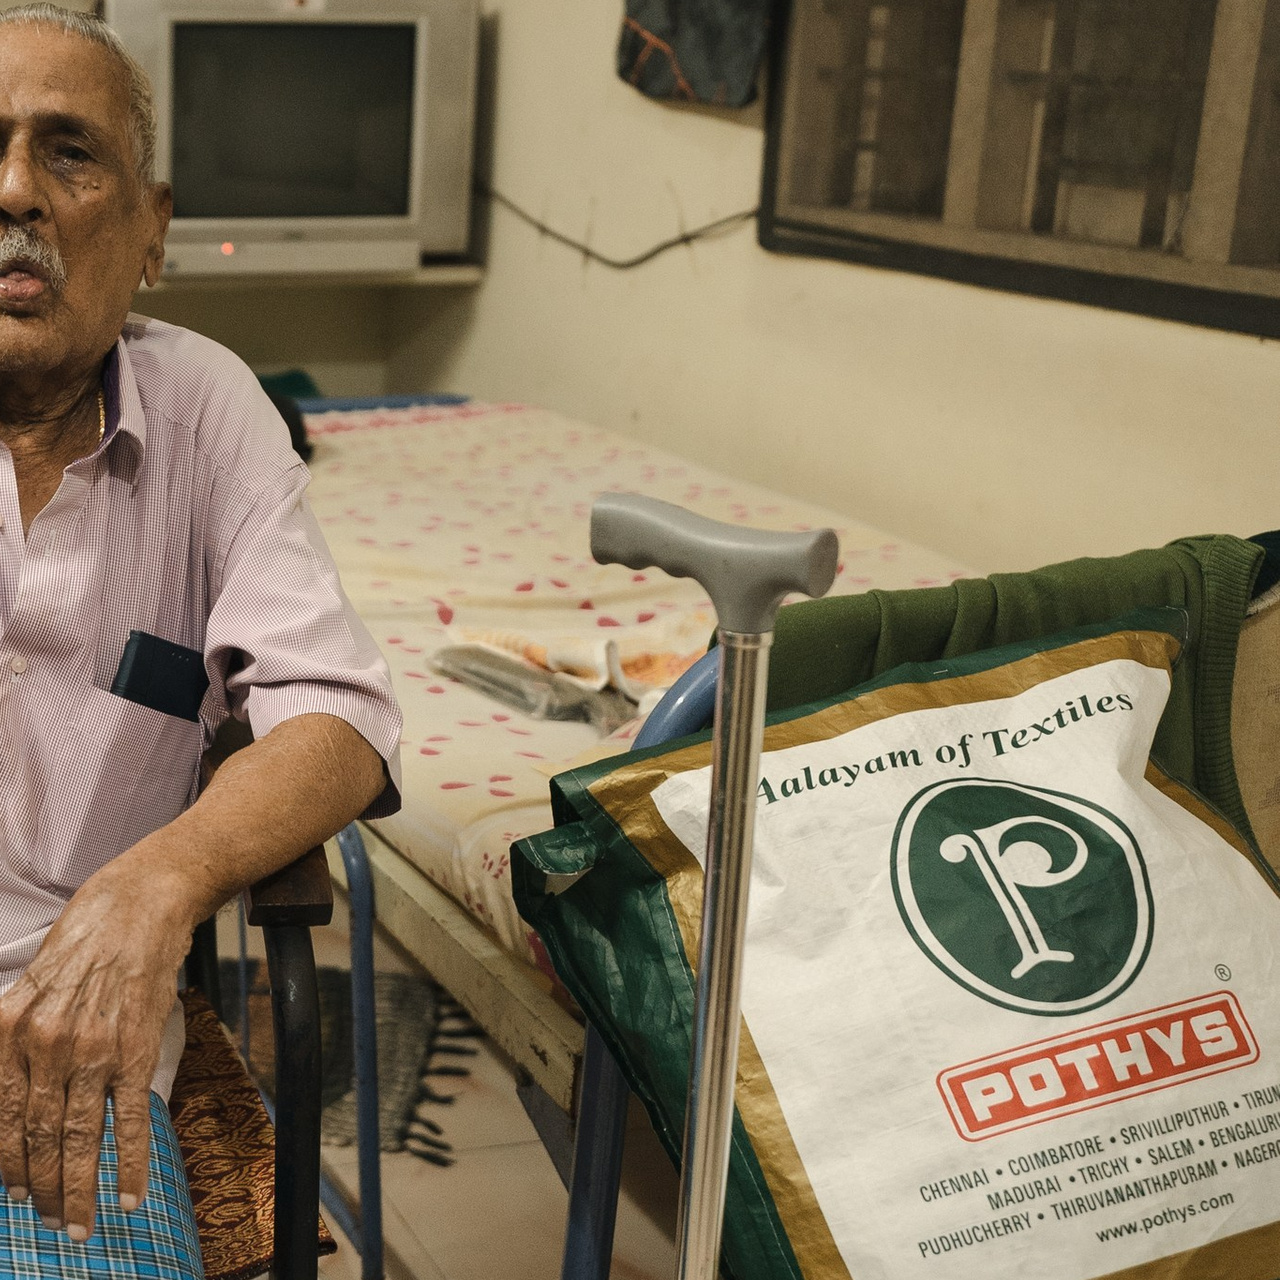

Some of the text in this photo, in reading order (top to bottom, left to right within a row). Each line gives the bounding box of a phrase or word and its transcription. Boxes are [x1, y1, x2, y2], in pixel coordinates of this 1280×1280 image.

[756, 690, 1133, 806] Aalayam of Textiles
[961, 1009, 1238, 1122] POTHYS
[919, 1168, 990, 1204] CHENNAI
[1007, 1135, 1105, 1178] COIMBATORE
[1120, 1100, 1230, 1145] SRIVILLIPUTHUR
[986, 1175, 1062, 1211] MADURAI
[1077, 1156, 1130, 1186] TRICHY
[1147, 1138, 1195, 1166] SALEM
[918, 1211, 1032, 1258] PUDHUCHERRY
[1050, 1159, 1219, 1222] THIRUVANANTHAPURAM
[1095, 1191, 1235, 1243] www.pothys.com
